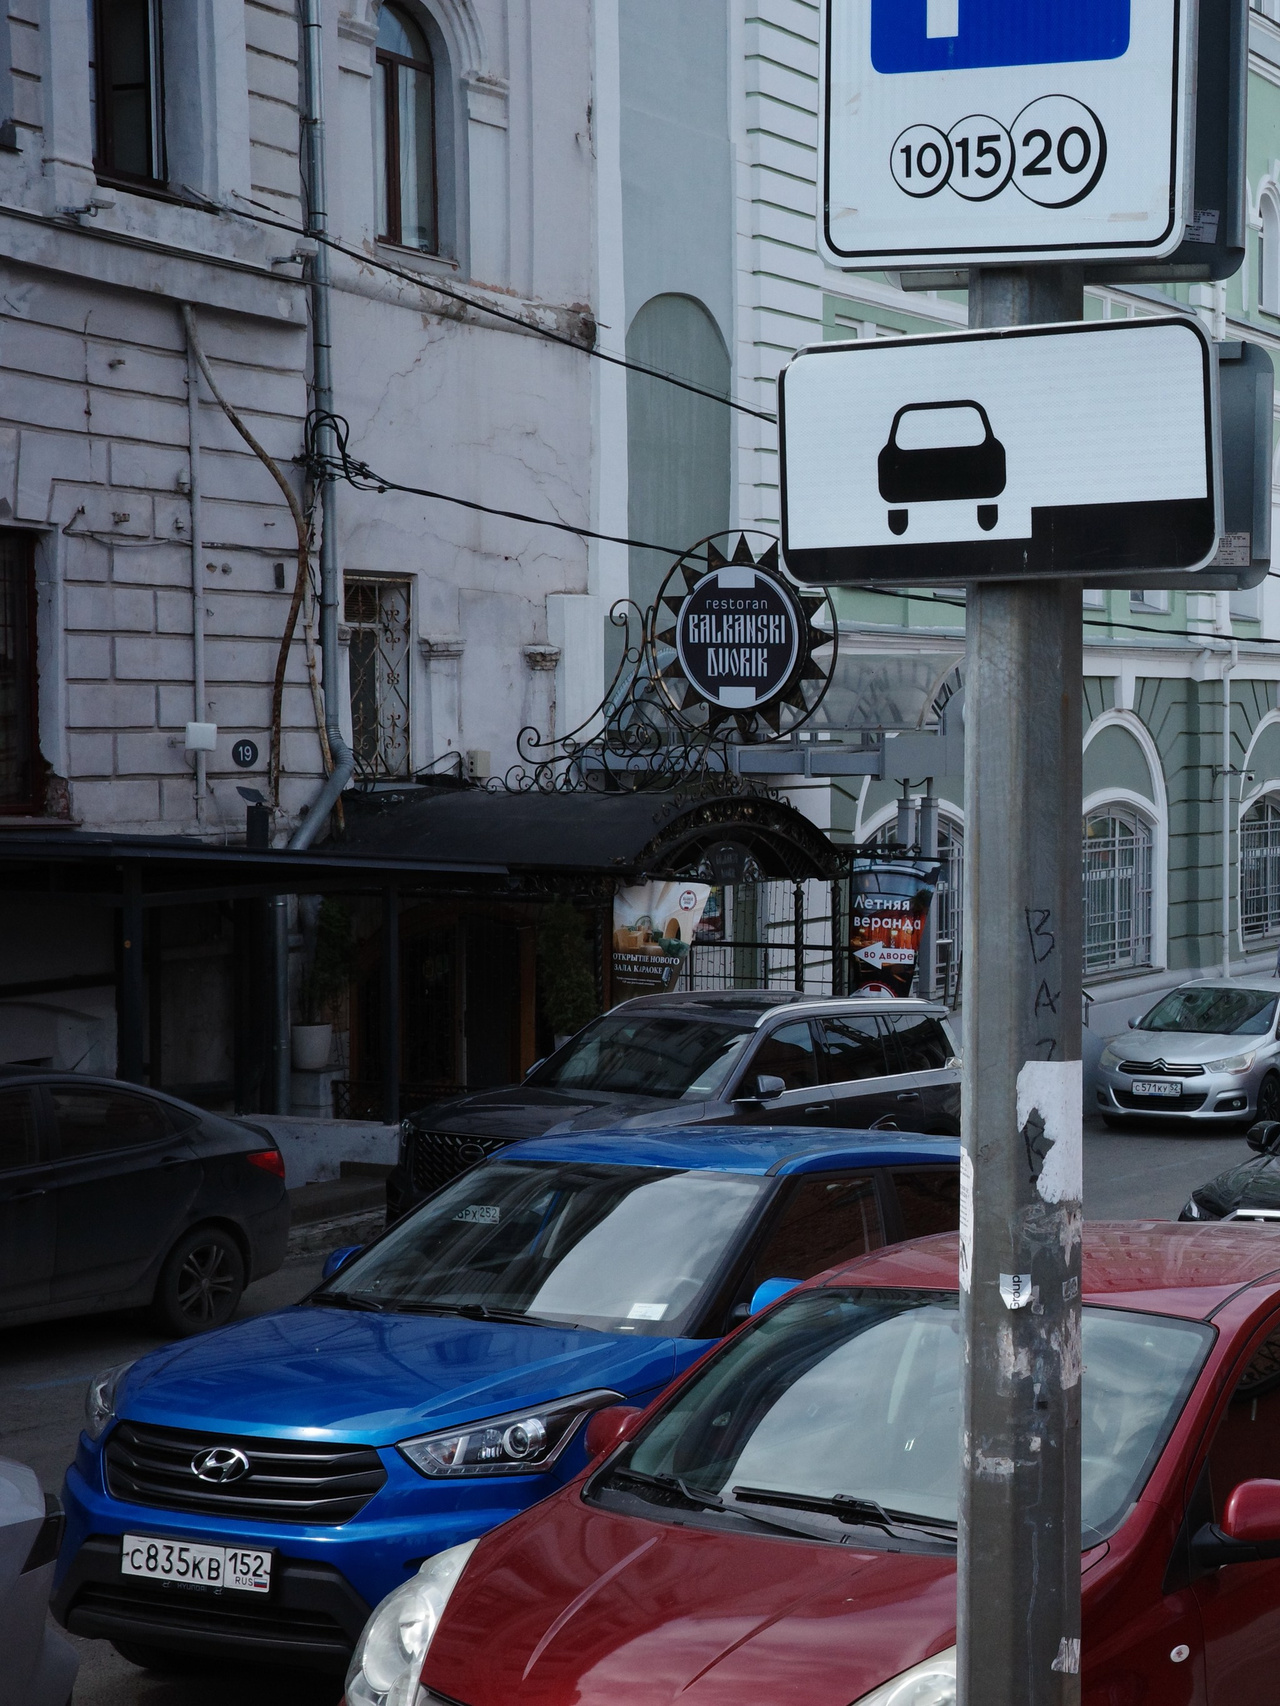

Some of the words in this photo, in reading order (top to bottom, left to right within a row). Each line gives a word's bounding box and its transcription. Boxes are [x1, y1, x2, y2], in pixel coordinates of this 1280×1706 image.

[899, 142, 942, 179] 10
[955, 134, 1001, 179] 15
[1021, 126, 1092, 177] 20
[706, 598, 768, 610] restoran
[688, 614, 786, 644] BALKANSKI
[707, 648, 768, 677] DVORIK
[238, 745, 252, 762] 19
[854, 895, 910, 911] Летняя
[853, 916, 921, 931] веранда
[650, 956, 680, 966] НОВОГО
[879, 952, 914, 962] дворе
[614, 963, 632, 972] ЗАЛА
[633, 965, 663, 974] КАРАОКЕ
[479, 1207, 497, 1218] 252
[1010, 1275, 1022, 1309] Group
[228, 1552, 264, 1578] 152
[177, 1582, 208, 1593] HYUNDAI
[235, 1576, 254, 1587] RUS
